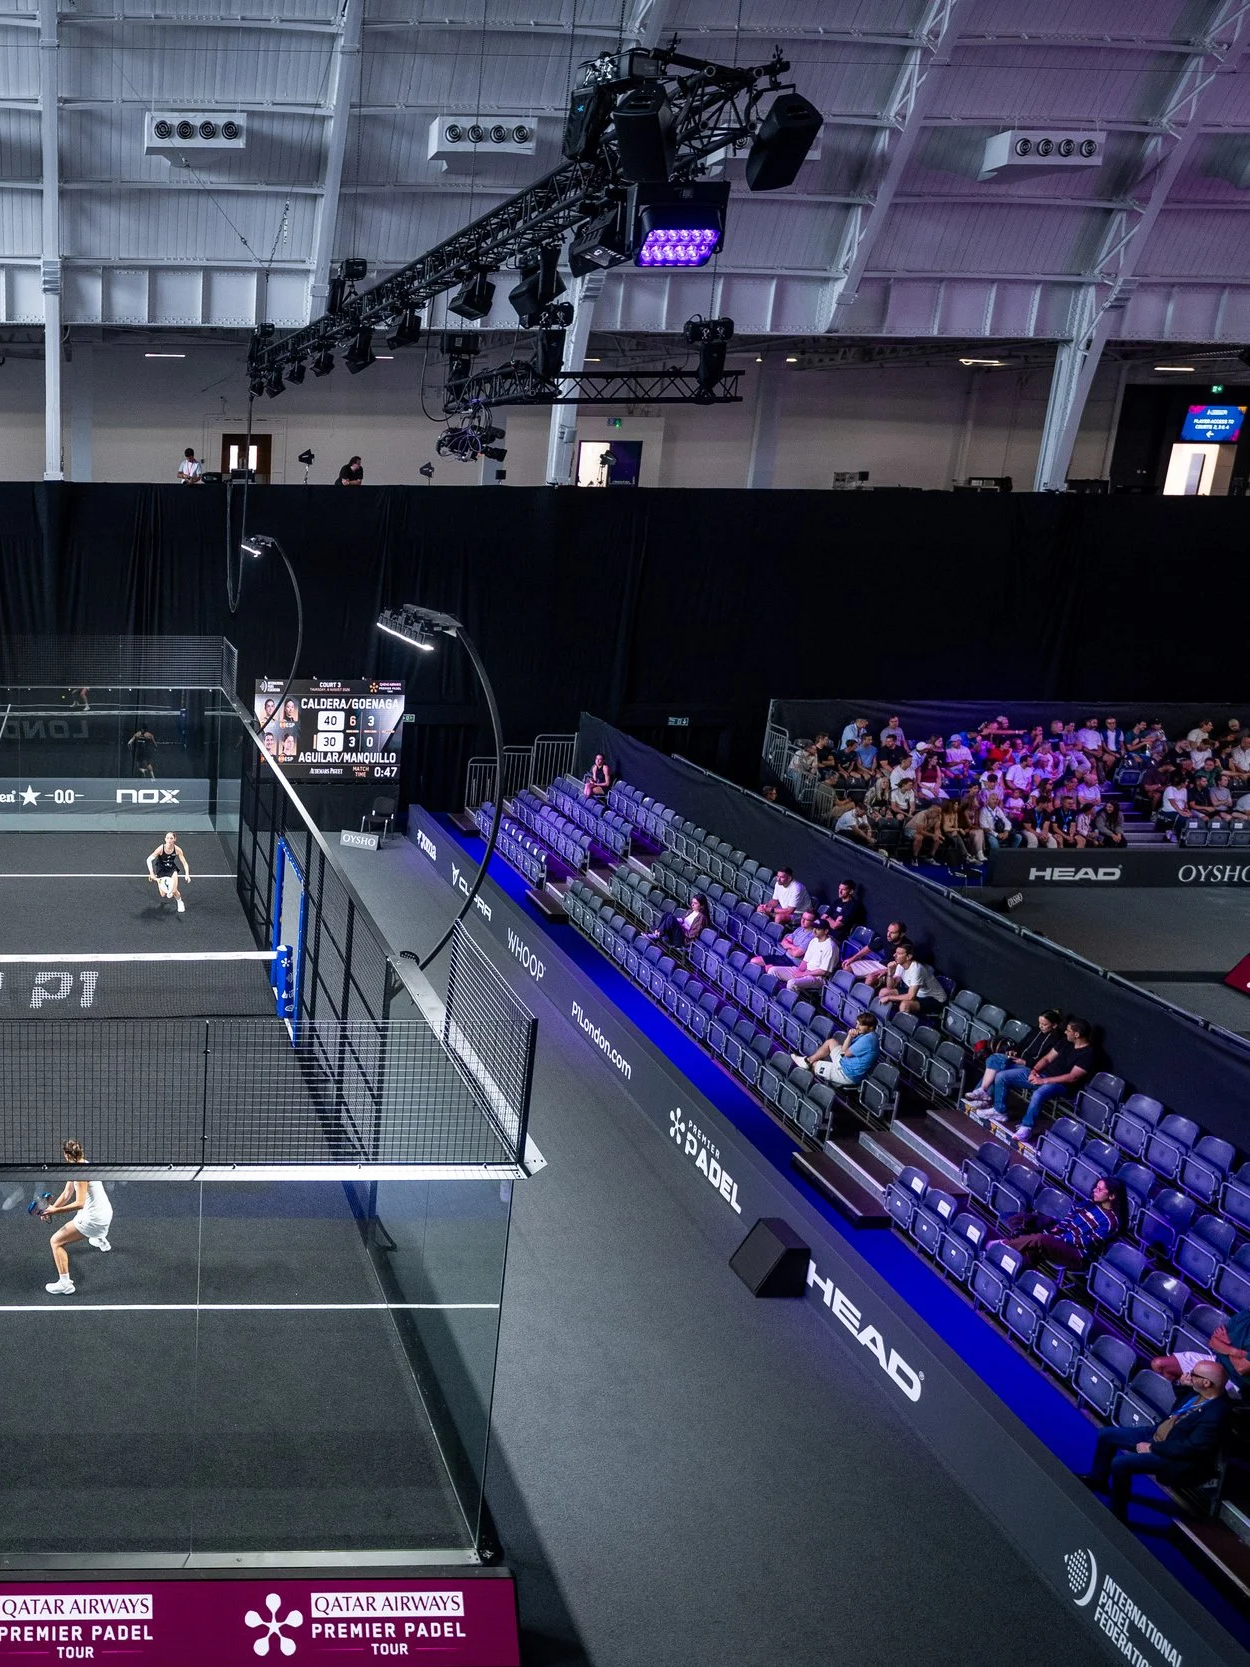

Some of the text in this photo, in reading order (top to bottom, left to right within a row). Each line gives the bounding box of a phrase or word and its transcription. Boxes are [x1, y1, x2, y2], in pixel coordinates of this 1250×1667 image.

[301, 698, 399, 709] CALDERA/GOENAGA
[324, 715, 374, 726] 40 6 3
[323, 737, 373, 747] 30 3 0
[298, 752, 396, 764] AGUILAR/MANQUILLO
[374, 767, 397, 777] 0:47
[342, 833, 376, 847] OYSHO
[1029, 867, 1121, 881] HEAD
[458, 876, 492, 921] CURA
[1008, 892, 1023, 908] OYSHO
[507, 928, 545, 981] WHOOP
[30, 971, 99, 1009] P1
[572, 1000, 632, 1080] P1London.com
[688, 1119, 720, 1160] PREMIER
[684, 1131, 742, 1215] PADEL
[806, 1259, 922, 1402] HEAD
[2, 1598, 149, 1618] QATAR AIRWAYS
[314, 1595, 461, 1615] QATAR AIRWAYS
[1098, 1590, 1130, 1637] PADEL
[91, 1625, 154, 1641] PADEL
[311, 1622, 467, 1638] PREMIER PADEL
[1094, 1606, 1152, 1667] FEDERATIO
[56, 1646, 94, 1659] TOUR
[371, 1643, 409, 1655] TOUR
